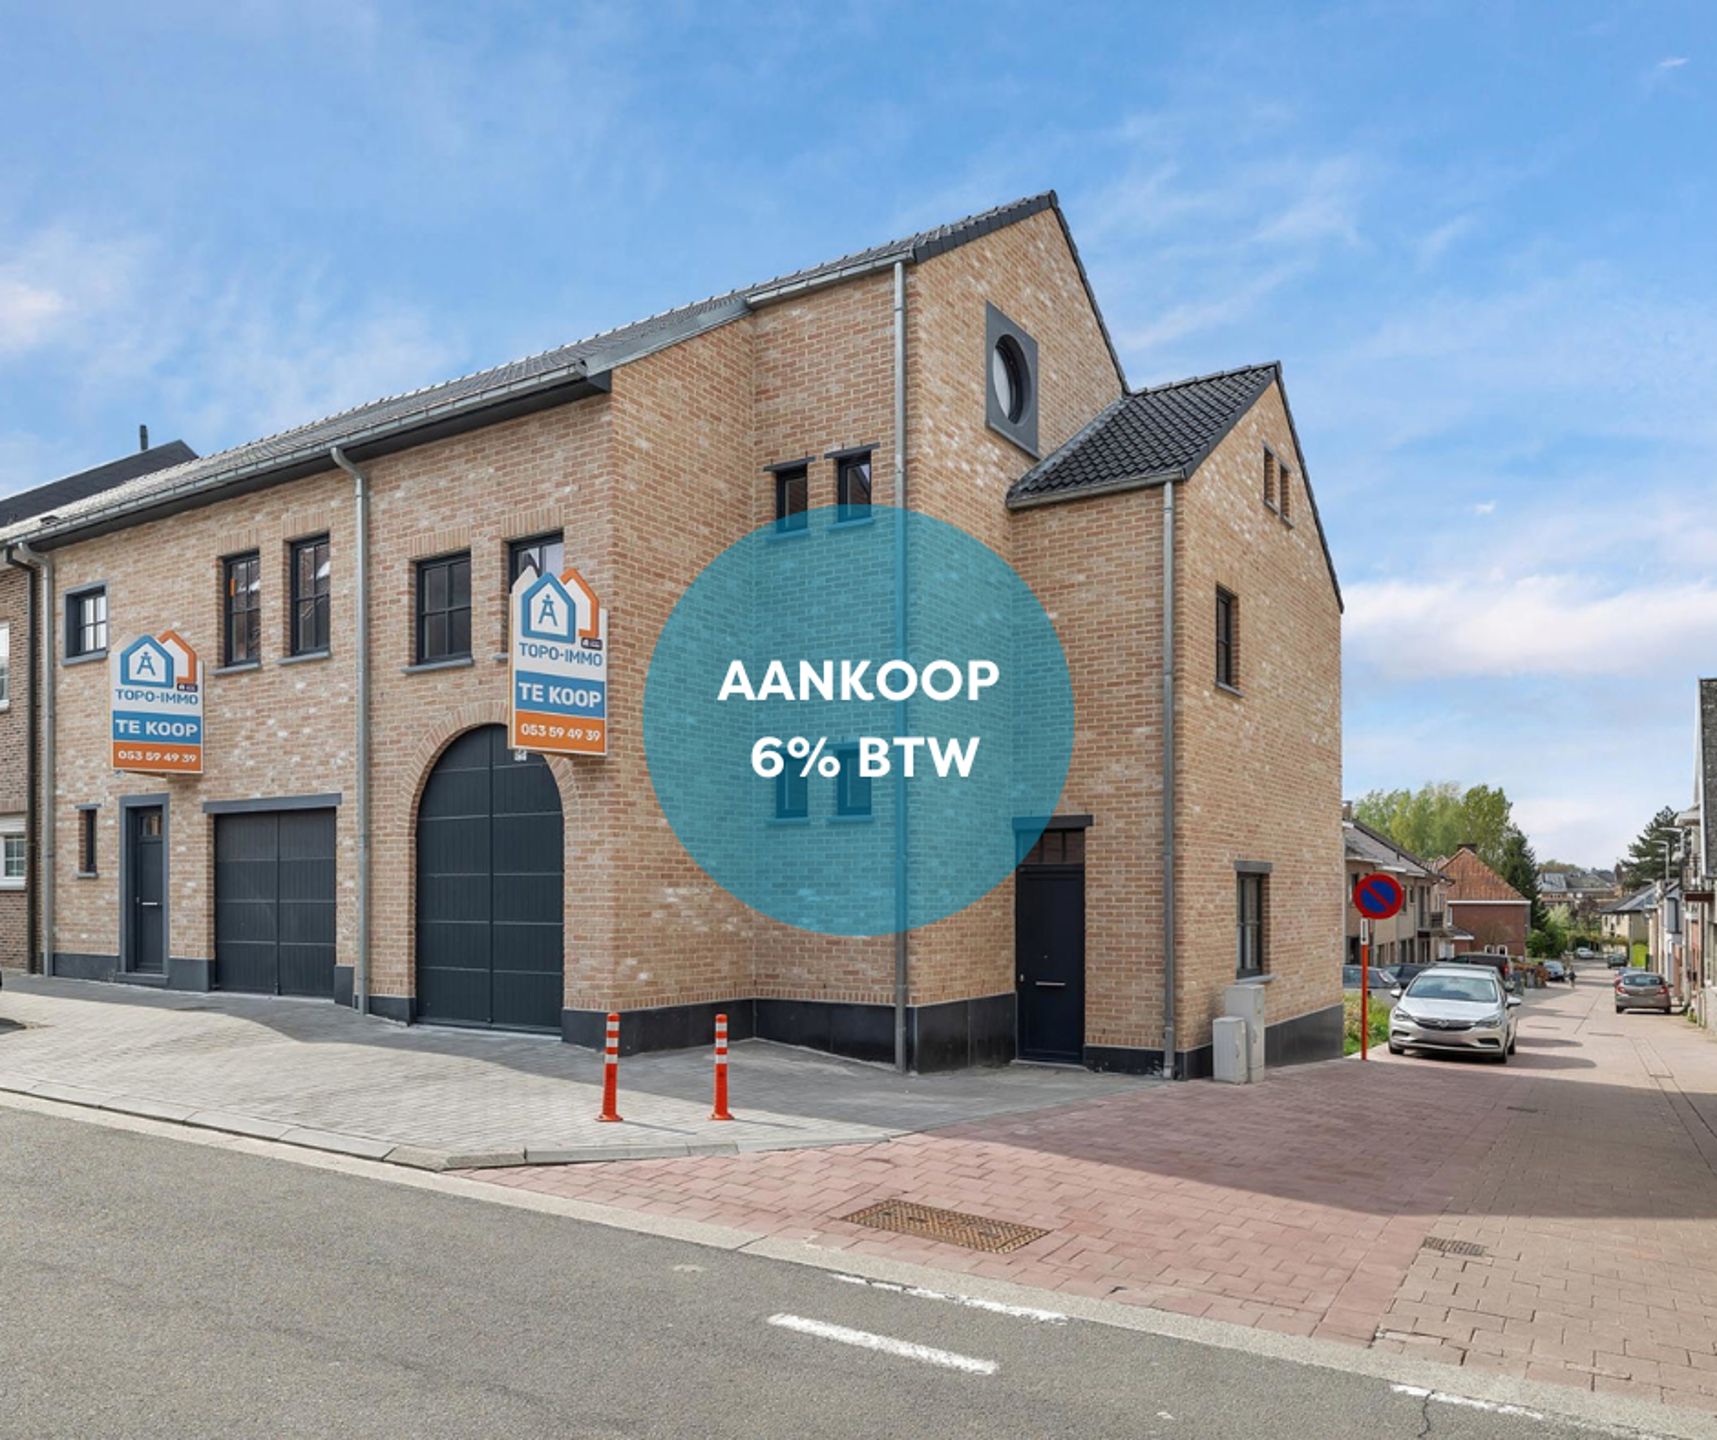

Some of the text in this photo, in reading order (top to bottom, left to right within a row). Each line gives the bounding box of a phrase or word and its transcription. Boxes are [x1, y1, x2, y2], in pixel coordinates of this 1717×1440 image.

[519, 642, 603, 666] TOPO-IMMO
[115, 689, 198, 705] TOPO-IMMO
[519, 682, 602, 708] TE KOOP
[116, 719, 198, 737] TE KOOP
[521, 723, 601, 742] 053 59 49 39
[118, 750, 143, 761] 053
[164, 752, 179, 762] 49
